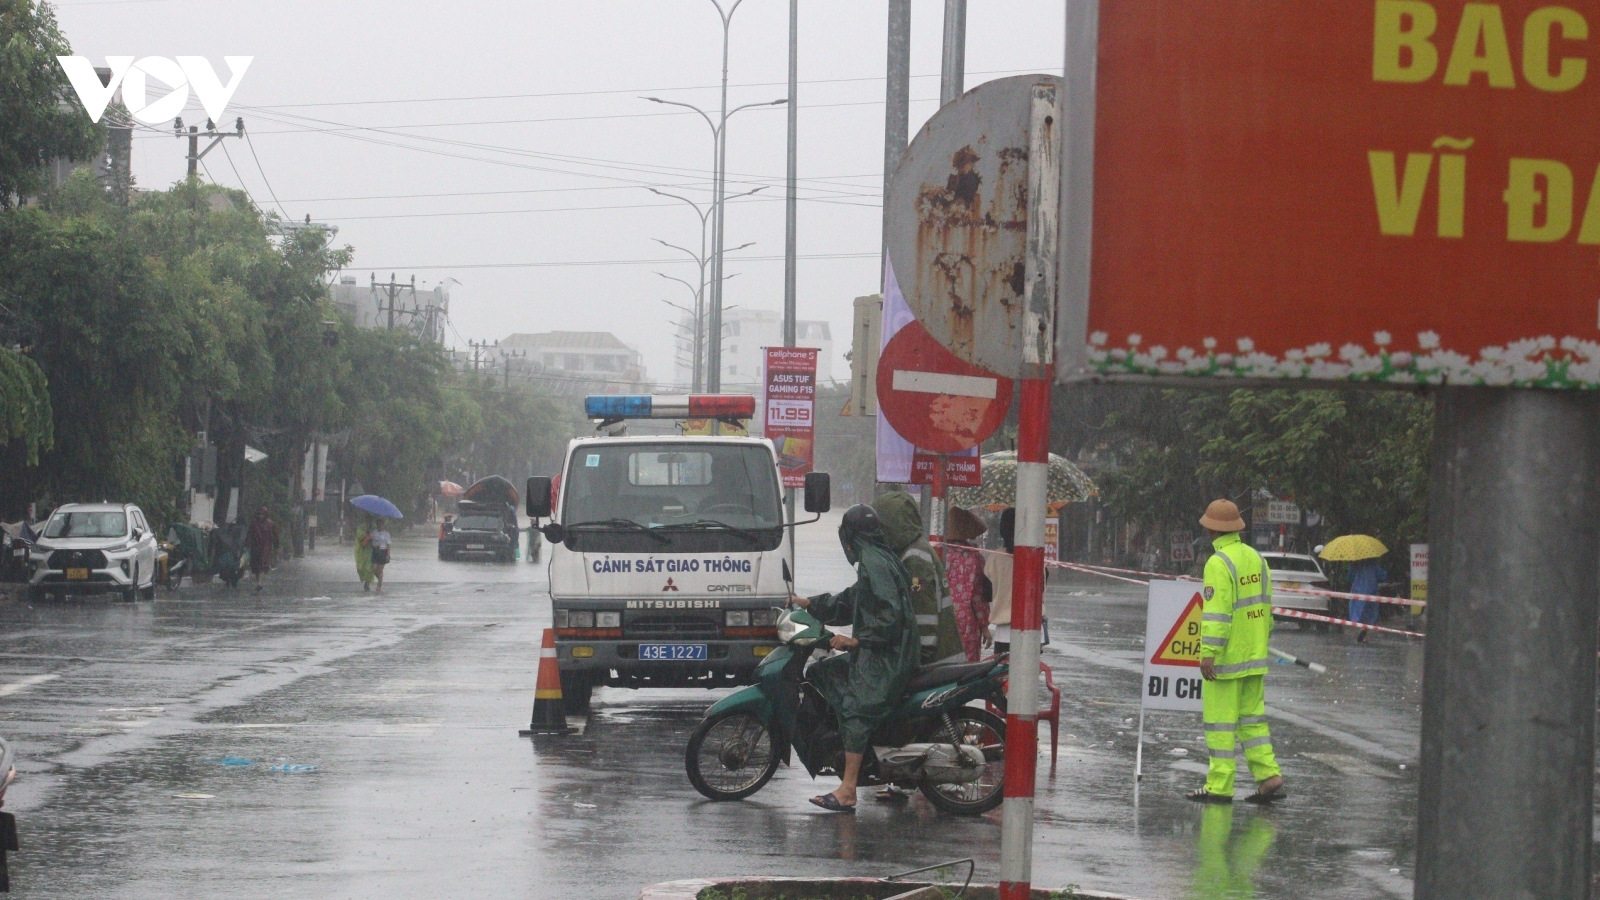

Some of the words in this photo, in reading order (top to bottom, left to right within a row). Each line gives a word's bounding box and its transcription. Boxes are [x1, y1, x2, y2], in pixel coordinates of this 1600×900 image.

[1367, 136, 1475, 239] VĨ
[773, 374, 794, 382] ASUS
[770, 384, 798, 392] GAMING
[770, 408, 810, 420] 11.99
[592, 555, 632, 573] CẢNH
[636, 556, 665, 572] SÁT
[666, 558, 699, 572] GIAO
[704, 556, 751, 573] THÔNG
[626, 600, 720, 609] MITSUBISHI
[643, 646, 667, 659] 43E
[672, 646, 703, 658] 1227
[1171, 638, 1201, 660] CHẬ
[1148, 676, 1169, 698] ĐI
[1175, 678, 1203, 700] CH
